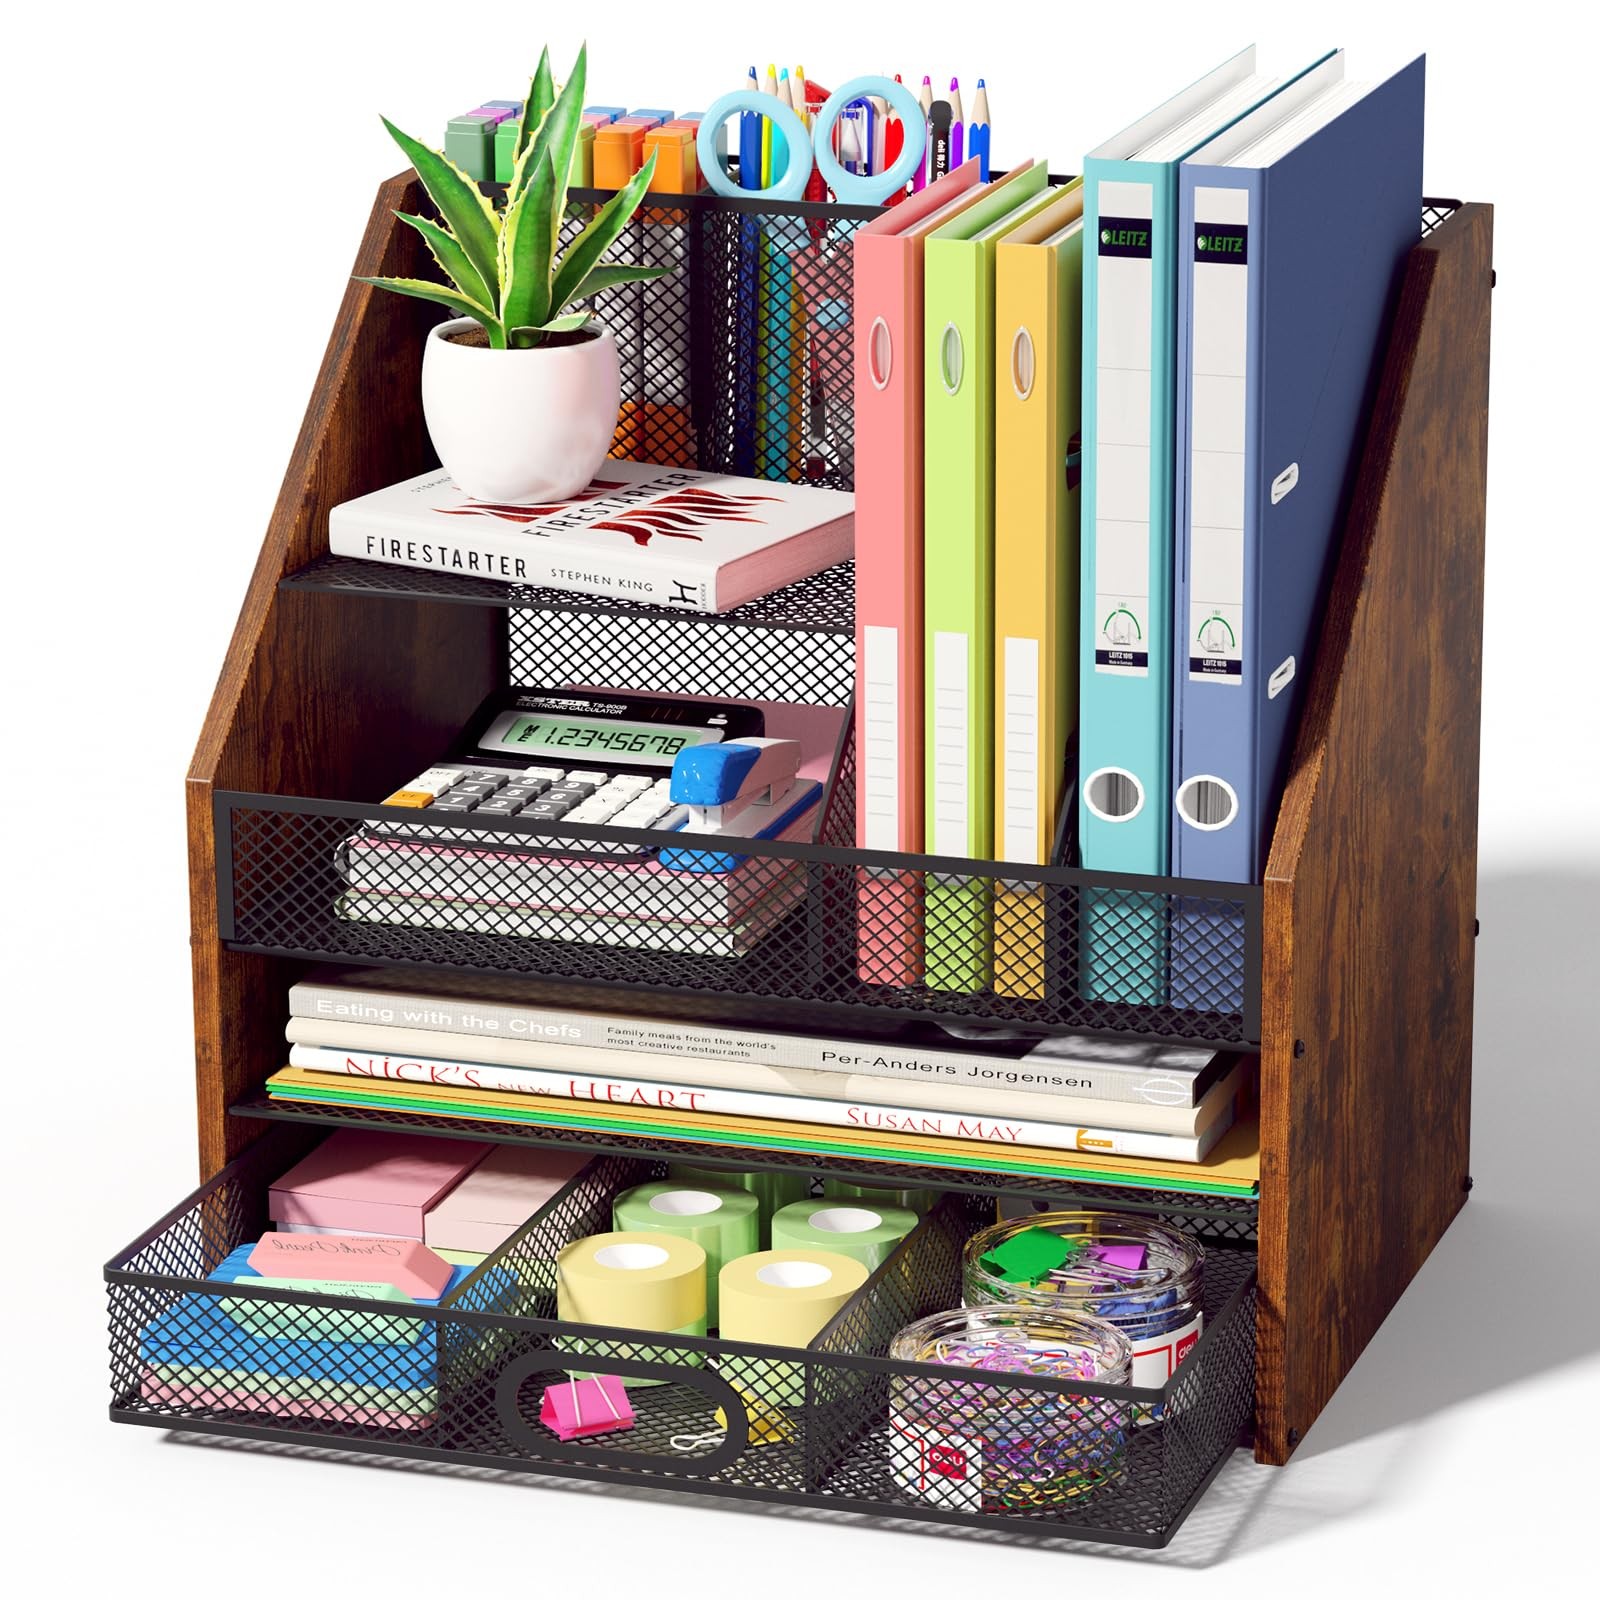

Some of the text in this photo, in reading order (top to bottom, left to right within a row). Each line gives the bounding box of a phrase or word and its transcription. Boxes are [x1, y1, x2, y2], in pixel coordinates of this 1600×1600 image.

[937, 139, 946, 153] deli
[1111, 229, 1148, 246] LEITZ
[1207, 235, 1245, 252] LEITZ
[521, 473, 703, 537] FIRESTARTER
[366, 535, 527, 578] FIRESTARTER
[551, 568, 653, 592] STEPHEN KING
[1108, 651, 1122, 659] LEITZ
[1202, 659, 1217, 667] LEITZ
[515, 701, 567, 710] ELECTRONIC
[569, 703, 623, 715] CALCULATOR
[545, 727, 687, 755] 1.2345678
[316, 999, 582, 1039] Eating with the Chefs
[607, 1026, 777, 1051] Family meals from the world's
[607, 1036, 751, 1058] most creative restaurants
[821, 1051, 1093, 1089] Per-Anders Jorgensen
[569, 1080, 706, 1110] HEART
[847, 1106, 1023, 1142] SUSAN MAY
